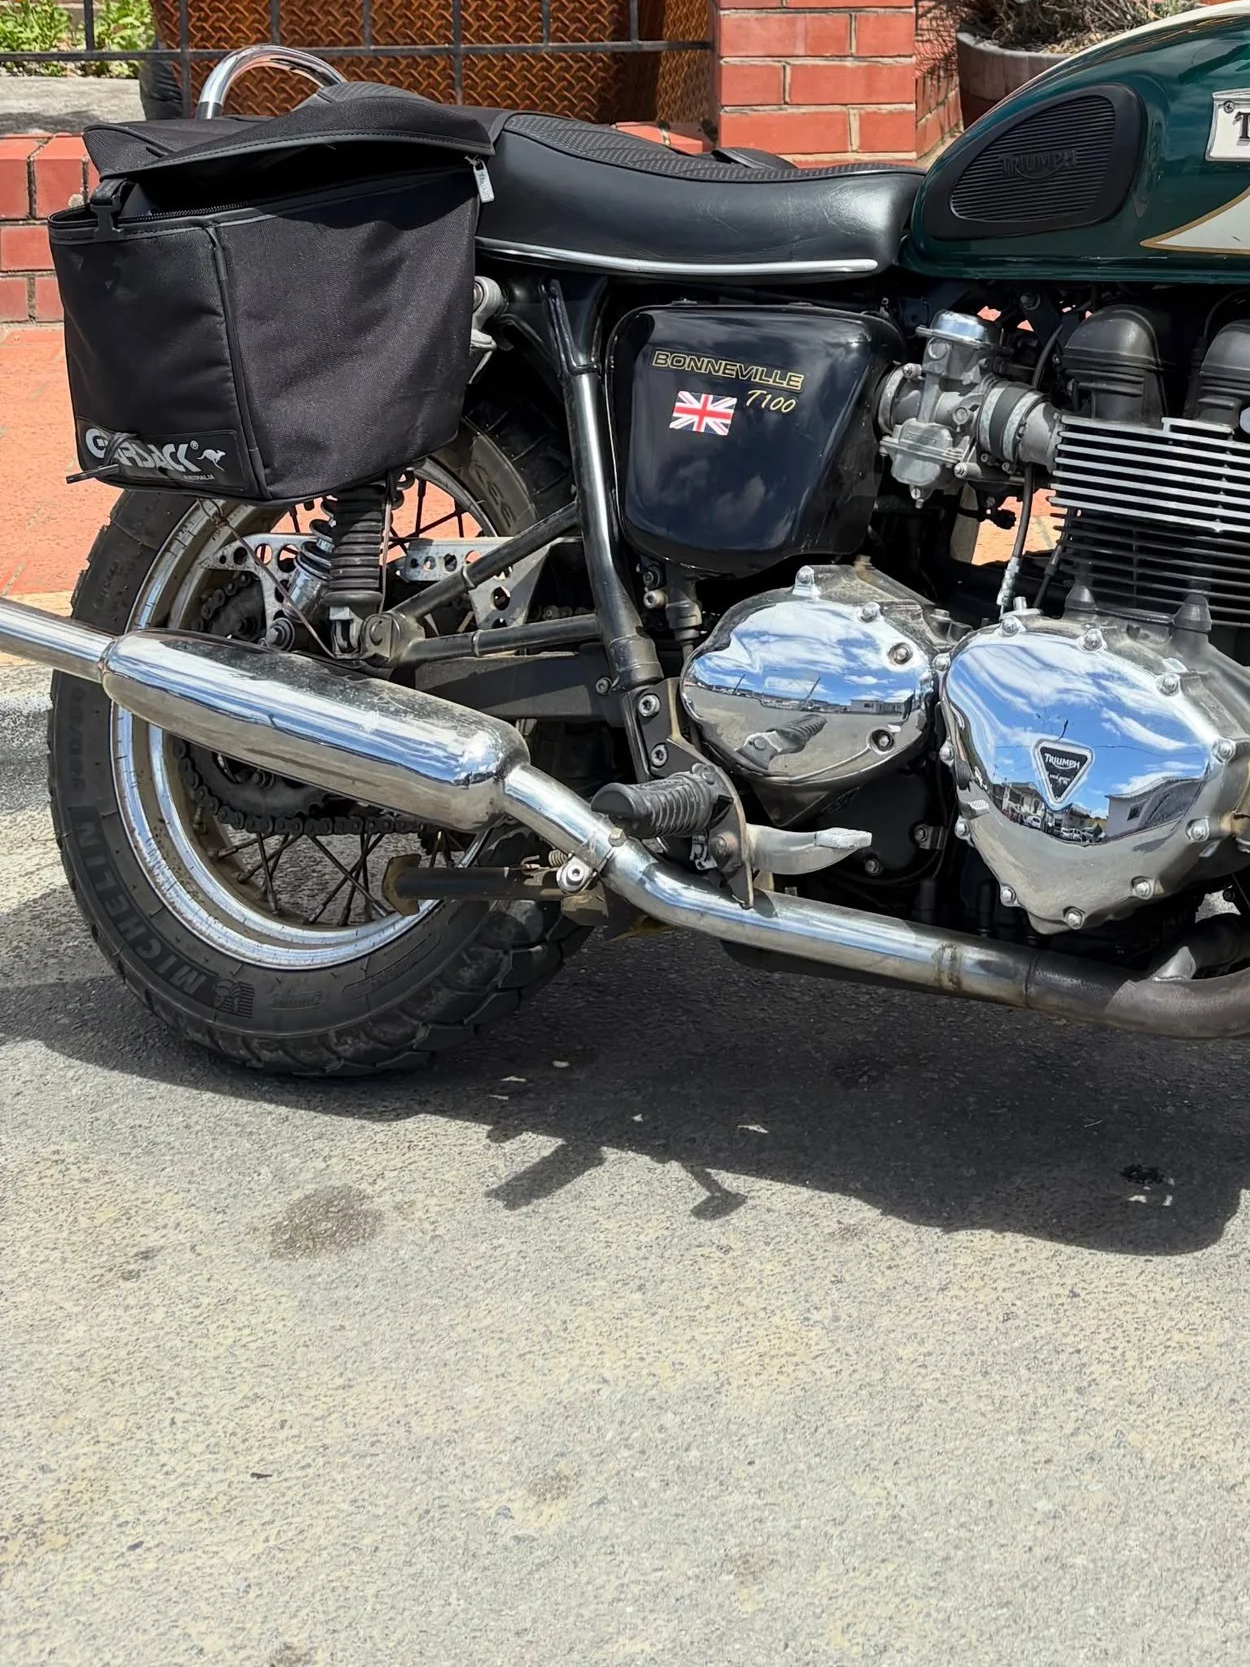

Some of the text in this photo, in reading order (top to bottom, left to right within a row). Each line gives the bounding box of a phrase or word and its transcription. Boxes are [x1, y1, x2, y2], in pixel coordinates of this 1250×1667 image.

[998, 149, 1077, 180] TRIUMPH
[651, 349, 804, 391] BONNEVILLE
[745, 389, 797, 414] T100
[1045, 753, 1080, 769] TRIUMPH
[76, 821, 208, 994] MICHELIN
